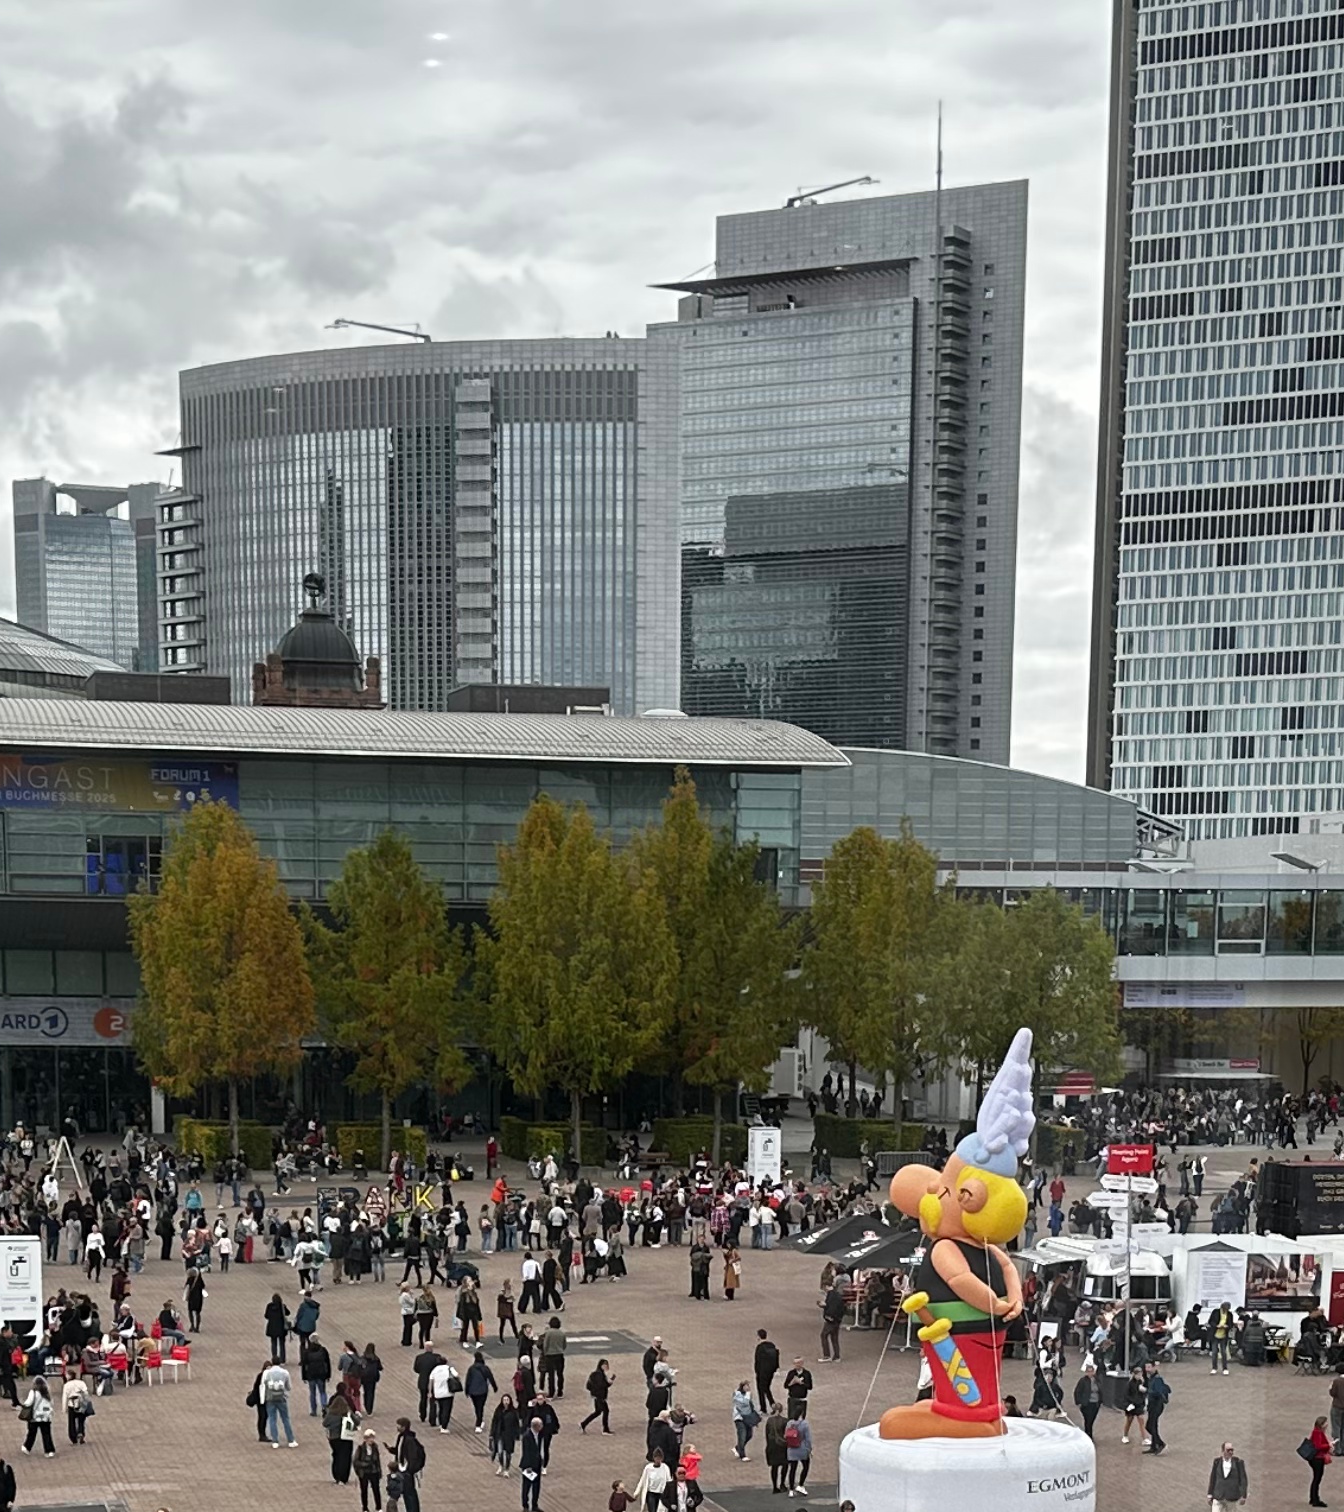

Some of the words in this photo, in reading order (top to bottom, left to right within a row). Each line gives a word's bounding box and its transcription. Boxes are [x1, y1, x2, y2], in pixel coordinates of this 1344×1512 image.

[6, 790, 87, 802] BUCHMESSE
[1, 1014, 41, 1030] ARD
[1027, 1470, 1090, 1493] EGMONT
